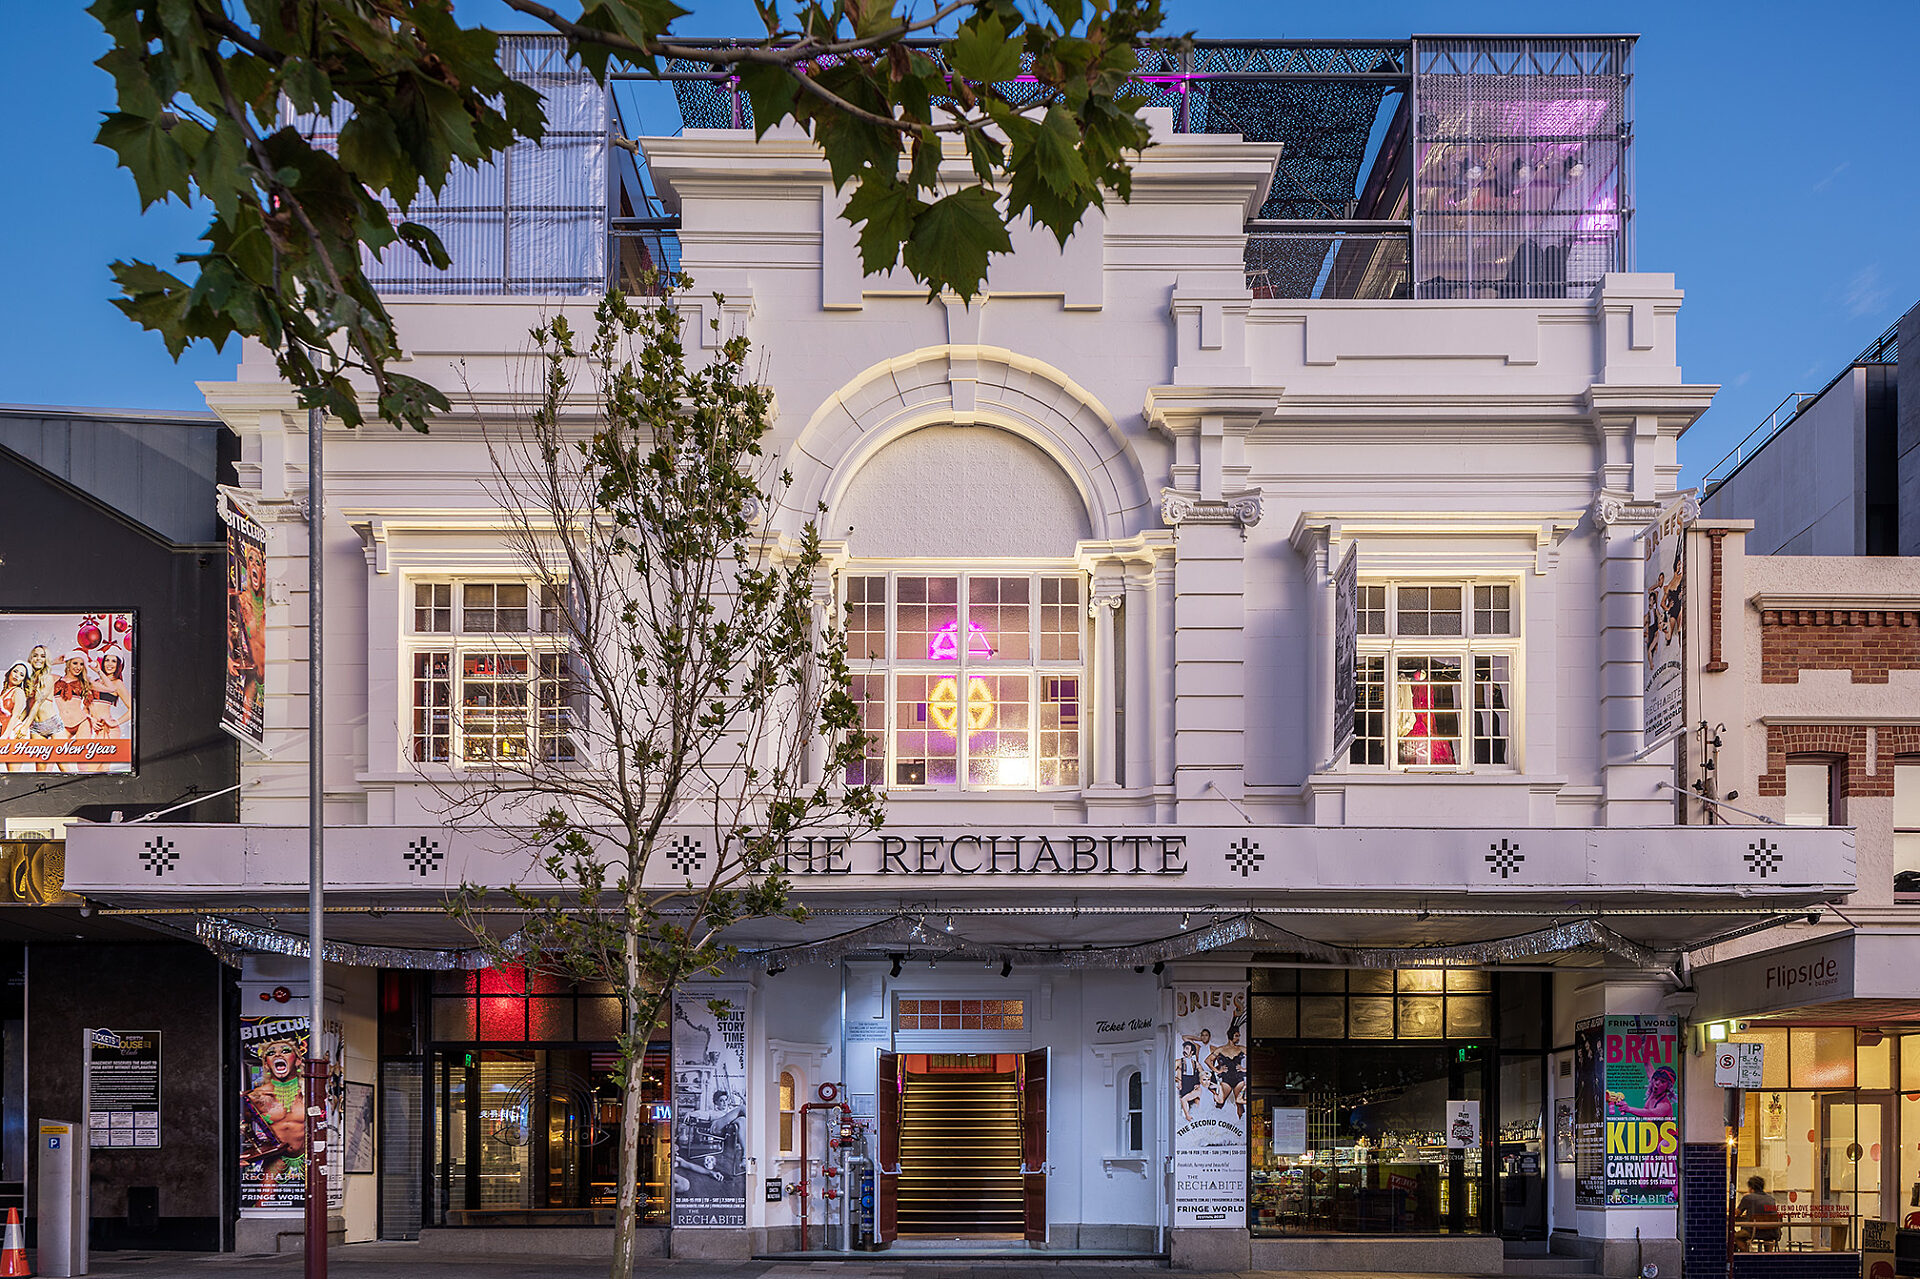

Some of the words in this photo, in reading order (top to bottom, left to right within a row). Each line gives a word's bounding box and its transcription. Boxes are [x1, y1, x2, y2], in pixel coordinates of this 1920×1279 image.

[1645, 507, 1684, 561] BRIEFS
[12, 742, 53, 761] Happy
[56, 740, 84, 756] New
[86, 742, 116, 759] Year
[878, 835, 1188, 875] RECHABITE
[1177, 989, 1245, 1017] BRIEFS
[717, 1022, 745, 1031] STORY
[1096, 1020, 1125, 1033] Ticket
[723, 1033, 744, 1042] TIME
[1606, 1034, 1677, 1064] BRAT
[1177, 1125, 1190, 1137] THE
[1190, 1119, 1216, 1130] SECOND
[1218, 1120, 1243, 1137] COMING
[51, 1138, 58, 1148] P
[1607, 1121, 1677, 1154] KIDS
[1607, 1162, 1676, 1178] CARNIVAL
[1177, 1181, 1244, 1191] RECHABITE
[1606, 1194, 1675, 1204] RECHABITE
[1796, 1204, 1808, 1212] LOVE
[1810, 1204, 1835, 1212] SINCERER
[1836, 1204, 1850, 1212] THAN
[678, 1215, 744, 1225] RECHABITE
[1865, 1229, 1883, 1240] TASTY
[1865, 1239, 1891, 1249] BURGERS
